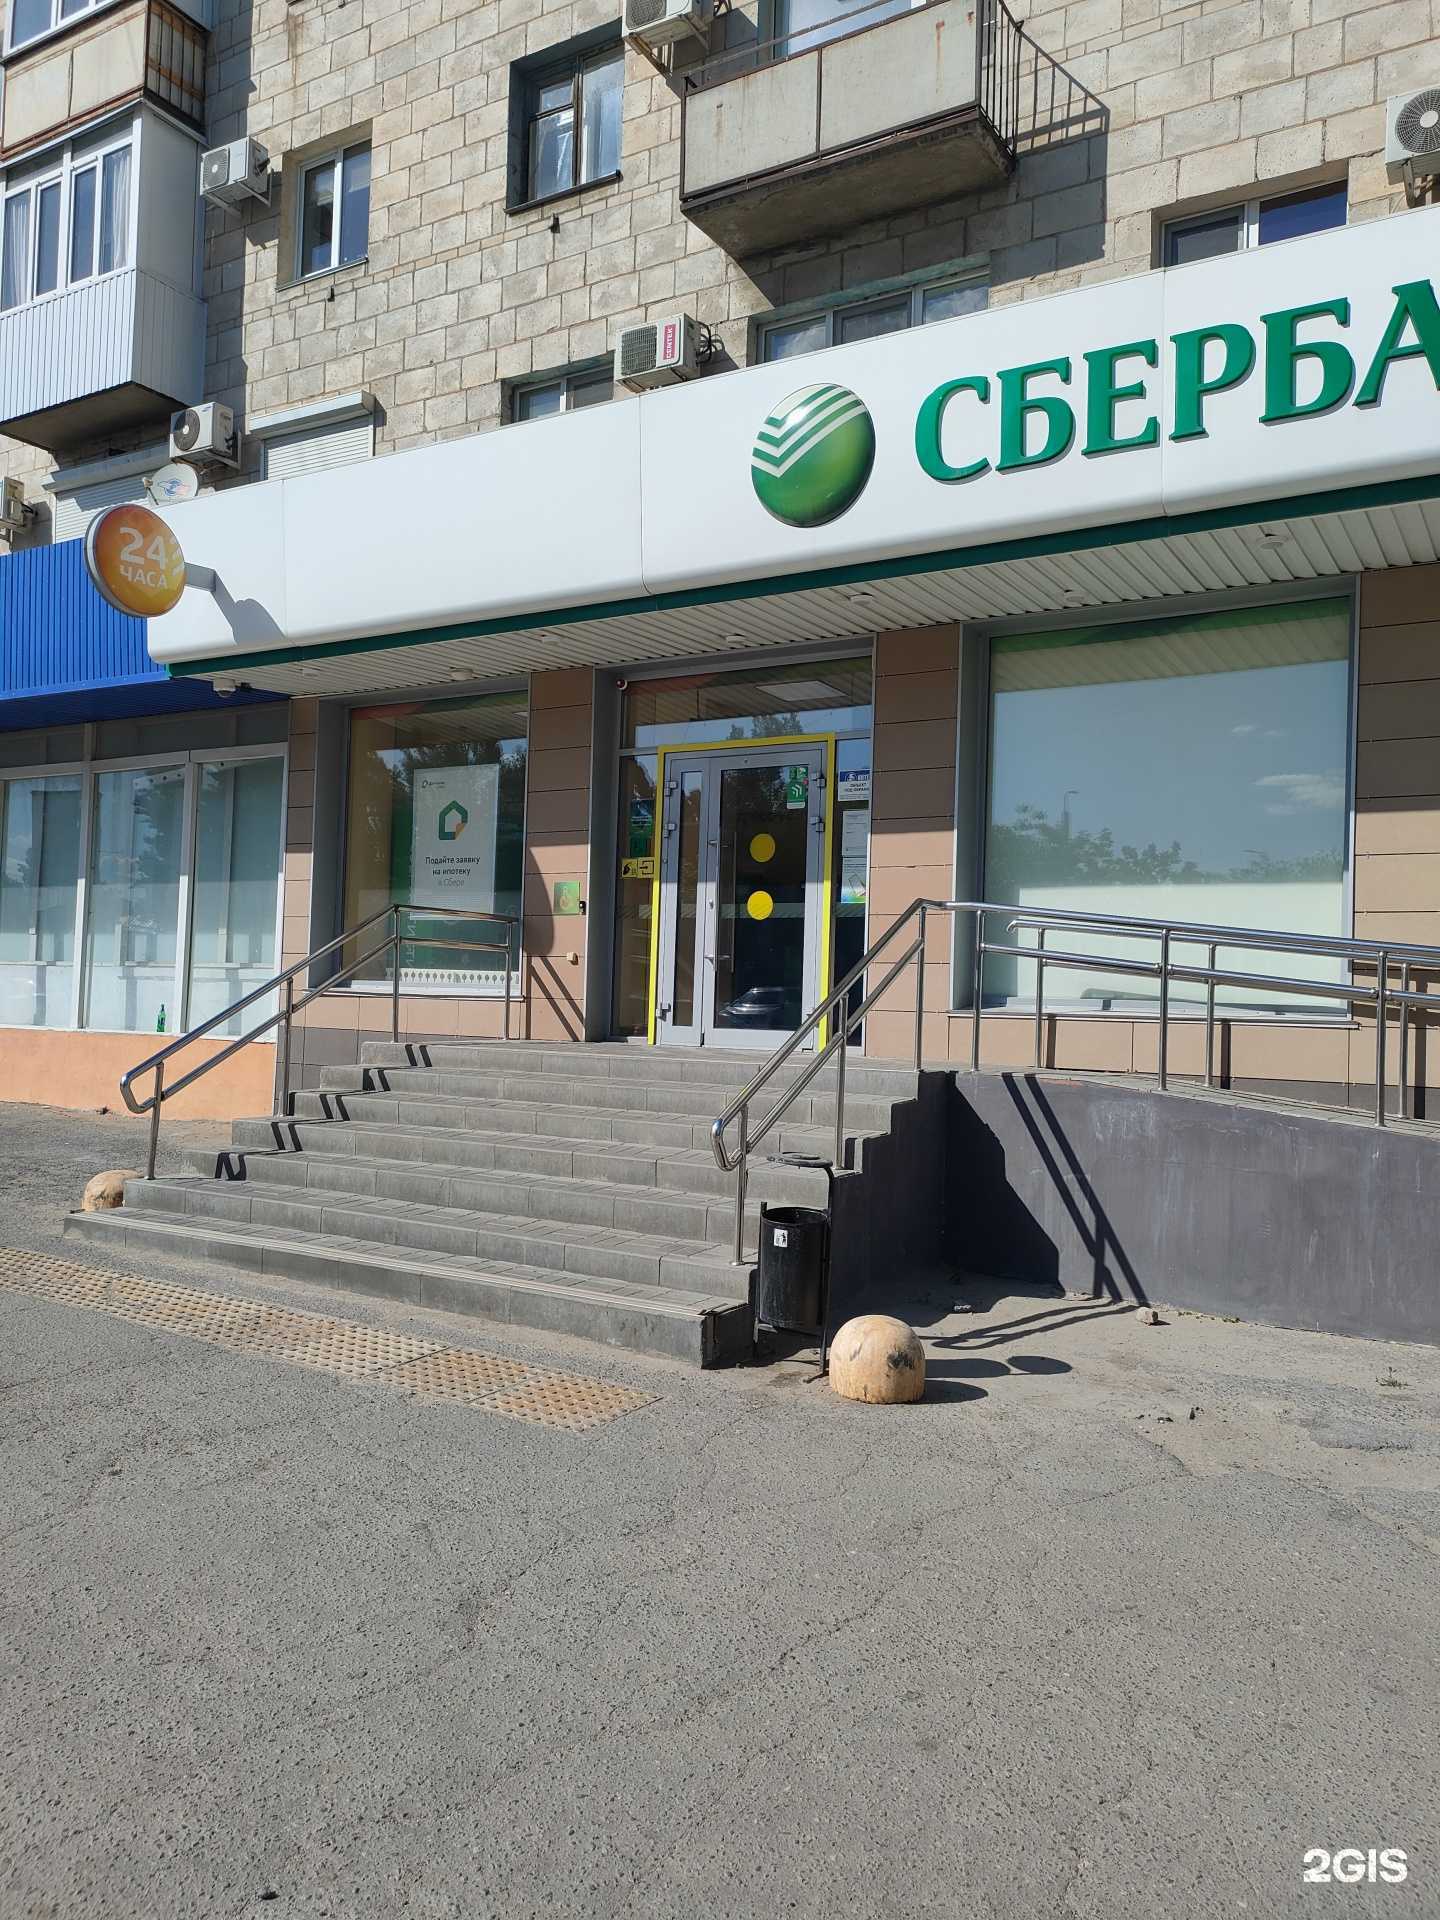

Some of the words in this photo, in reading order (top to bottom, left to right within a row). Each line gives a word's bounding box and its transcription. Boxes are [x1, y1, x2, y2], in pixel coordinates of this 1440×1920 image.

[915, 279, 1440, 482] СБЕРБА
[119, 526, 169, 571] 24
[119, 564, 169, 590] ЧАСА
[425, 856, 455, 865] Подайте
[456, 856, 481, 865] заявку
[432, 868, 441, 876] на
[443, 868, 471, 876] ипотеку
